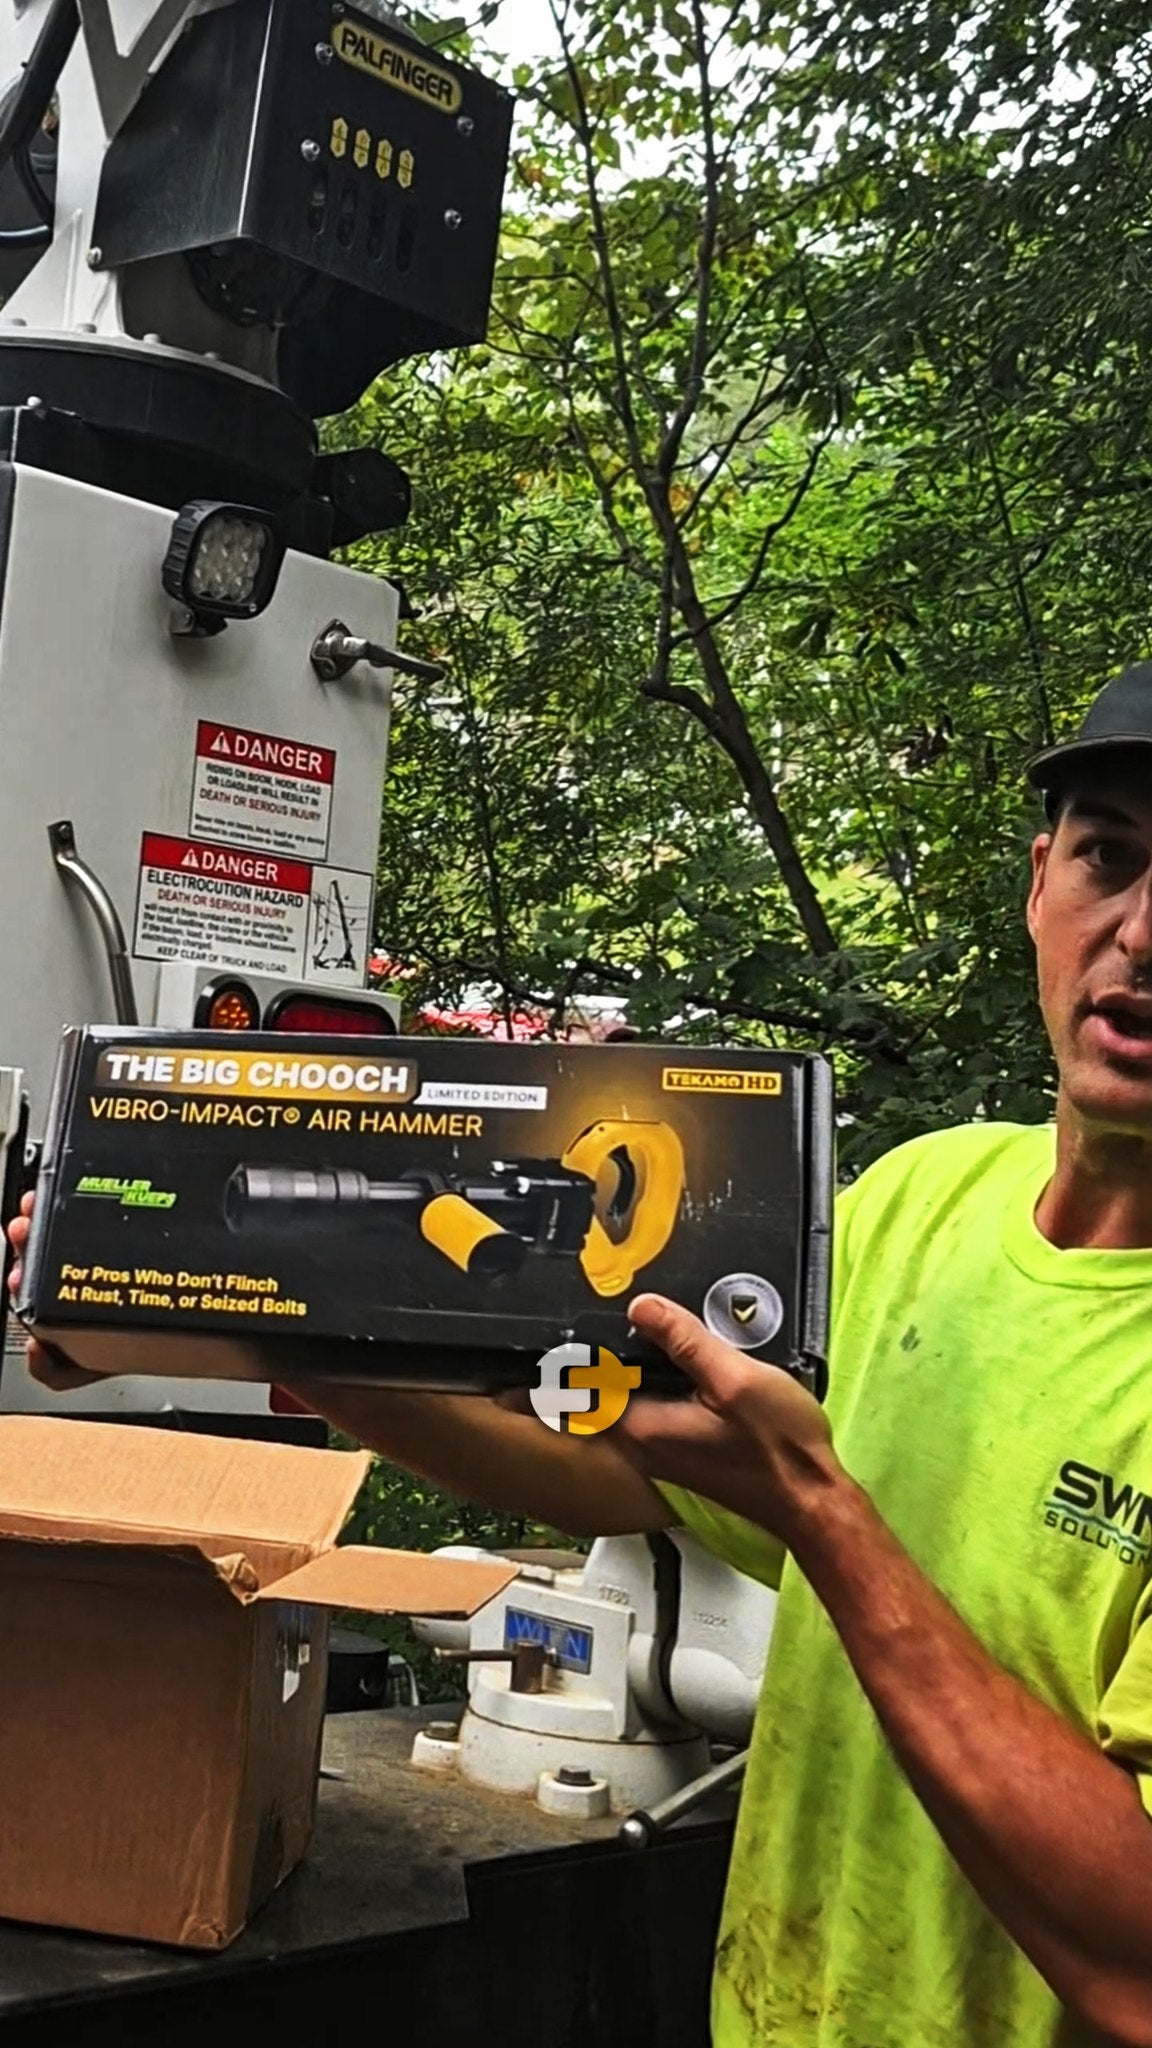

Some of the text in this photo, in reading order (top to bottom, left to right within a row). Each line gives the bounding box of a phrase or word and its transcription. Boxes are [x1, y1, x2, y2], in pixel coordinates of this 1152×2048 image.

[341, 28, 453, 106] PALFINGER
[235, 735, 322, 774] DANGER
[207, 775, 219, 785] OR
[280, 791, 309, 804] RESULT
[235, 769, 246, 778] ON
[300, 784, 321, 795] LOAD
[199, 788, 321, 820] DEATH OR SERIOUS INJURY
[202, 851, 278, 881] DANGER
[147, 869, 304, 908] ELECTROCUTION HAZARD
[157, 888, 287, 920] DEATH OR SERIOUS INJURY
[157, 946, 287, 974] KEEP CLEAR OF TRUCK AND LOAD
[106, 1053, 408, 1094] THE BIG CHOOCH
[670, 1073, 777, 1090] TEKAMO HD
[427, 1088, 537, 1103] LIMITED EDITION
[307, 1108, 351, 1131] AIR
[360, 1110, 482, 1137] HAMMER
[61, 1264, 278, 1293] For Pros Who Don't Flinch
[58, 1284, 307, 1316] At Rust, Time, or Seized Bolts
